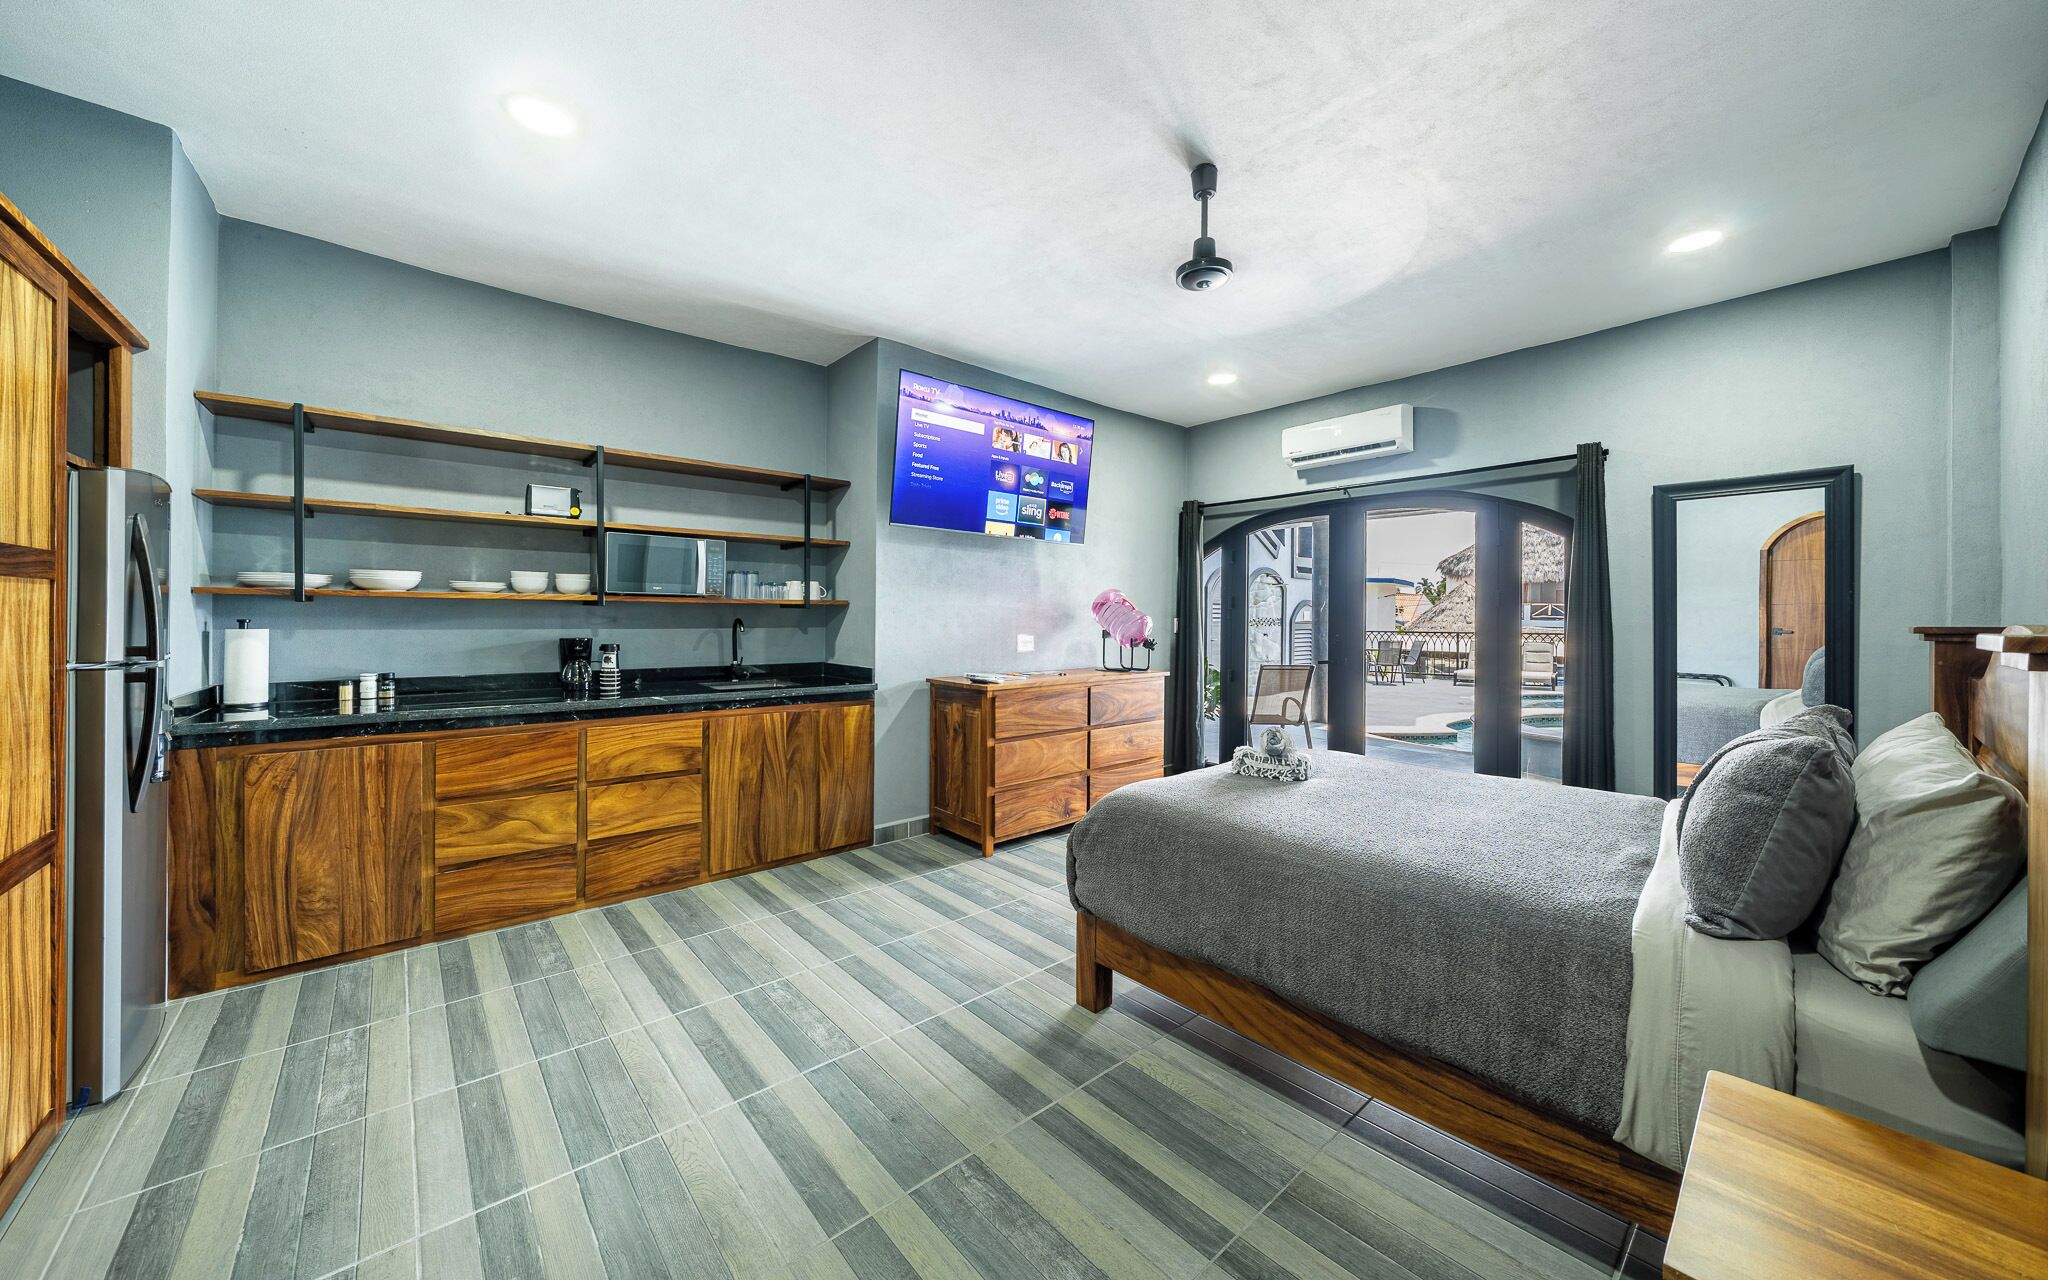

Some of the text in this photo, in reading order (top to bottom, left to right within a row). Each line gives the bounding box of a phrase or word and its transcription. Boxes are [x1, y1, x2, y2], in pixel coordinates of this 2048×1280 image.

[913, 383, 941, 395] Roku TV
[914, 432, 940, 441] Subscriptions
[912, 462, 929, 470] Featured
[911, 472, 932, 480] Streaming
[1022, 505, 1042, 519] sling
